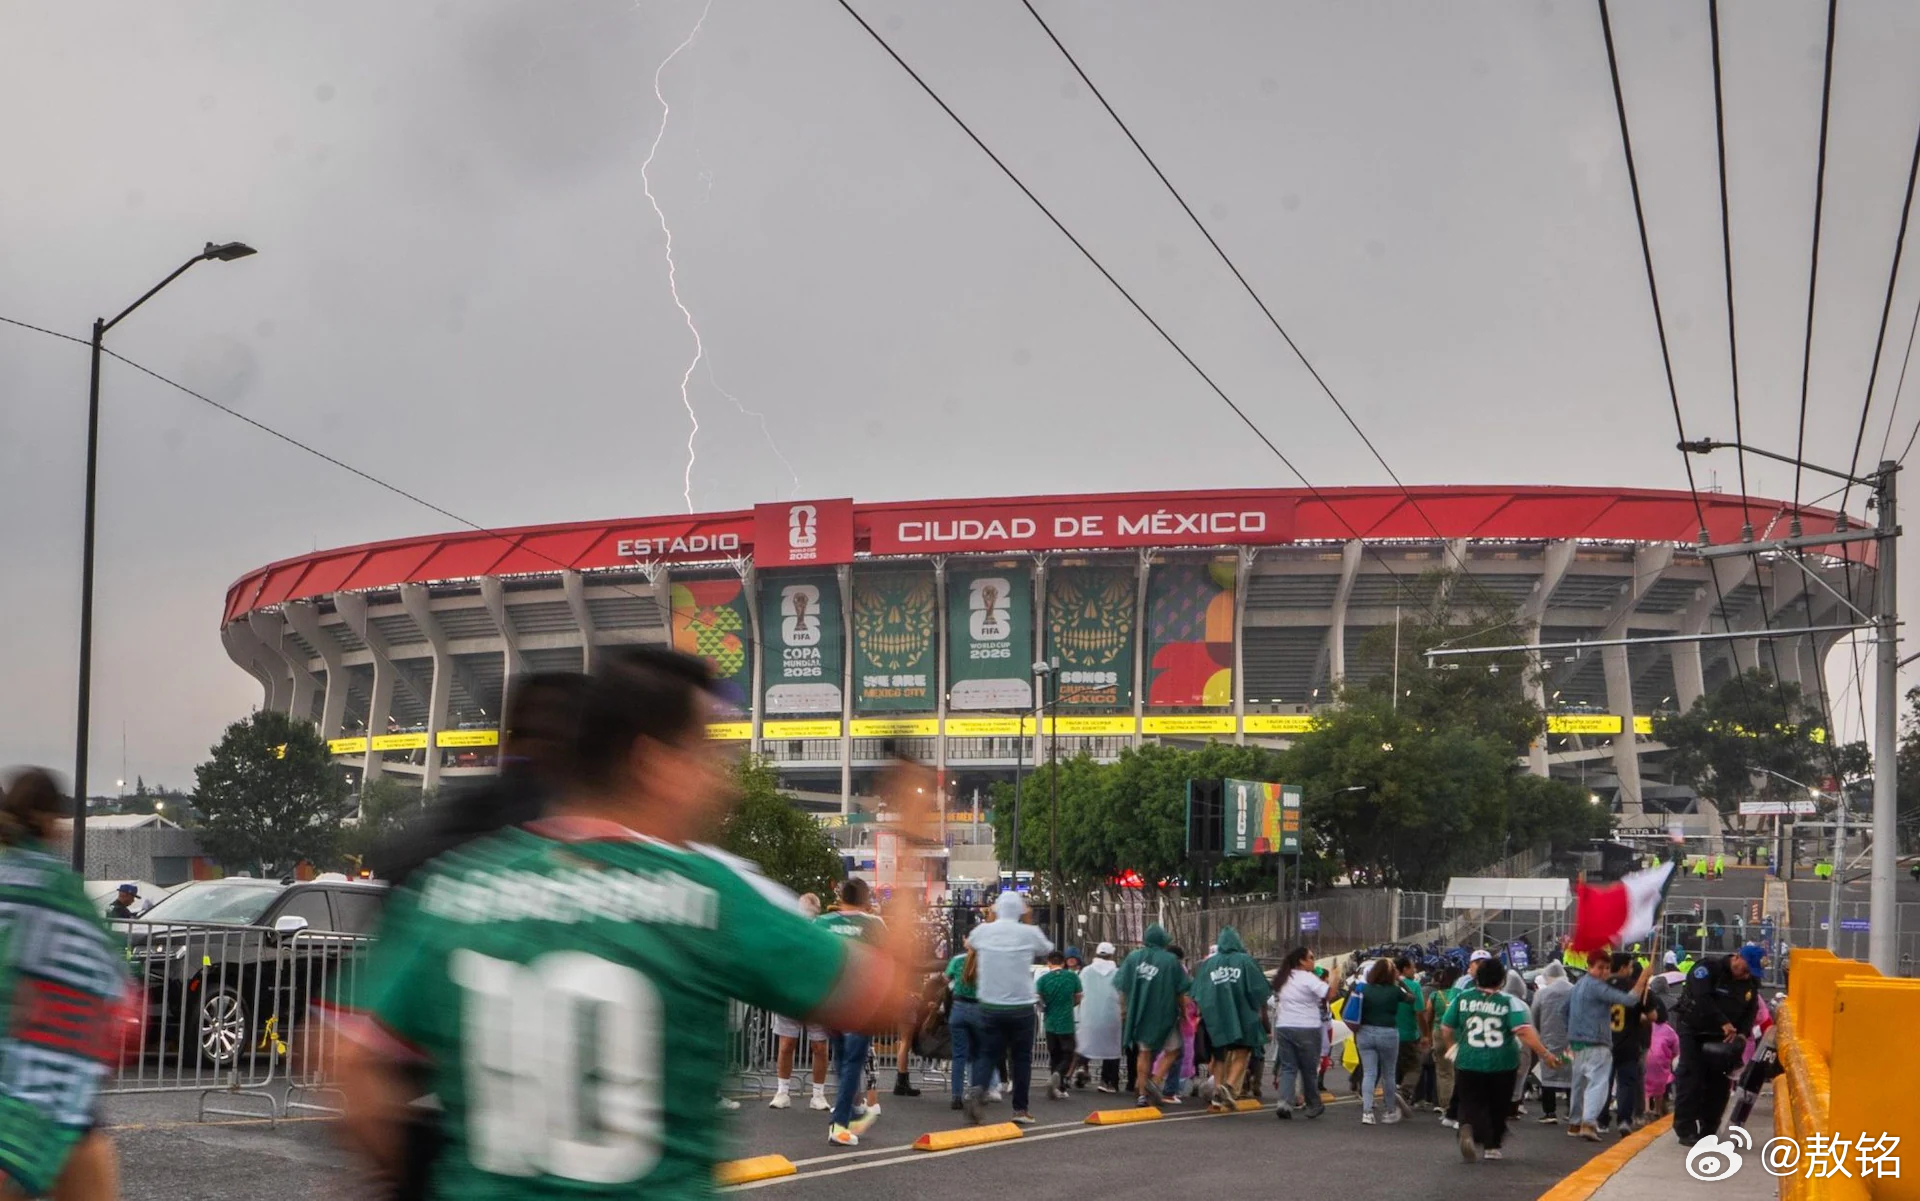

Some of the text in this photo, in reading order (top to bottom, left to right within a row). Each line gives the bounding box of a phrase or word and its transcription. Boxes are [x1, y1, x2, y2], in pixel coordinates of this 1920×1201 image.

[899, 509, 1266, 542] CIUDAD DE MÉXICO
[617, 533, 739, 557] ESTADIO
[789, 552, 816, 560] 2026
[793, 633, 810, 641] FIFA
[982, 627, 999, 635] FIFA
[782, 647, 821, 660] COPA
[970, 649, 1011, 660] 2026
[782, 659, 821, 668] MUNDIAL
[783, 667, 822, 678] 2026
[1060, 671, 1118, 684] SOMOS
[863, 674, 927, 687] WE ARE
[903, 687, 926, 697] CITY
[1466, 1016, 1504, 1048] 26
[449, 947, 665, 1183] 10
